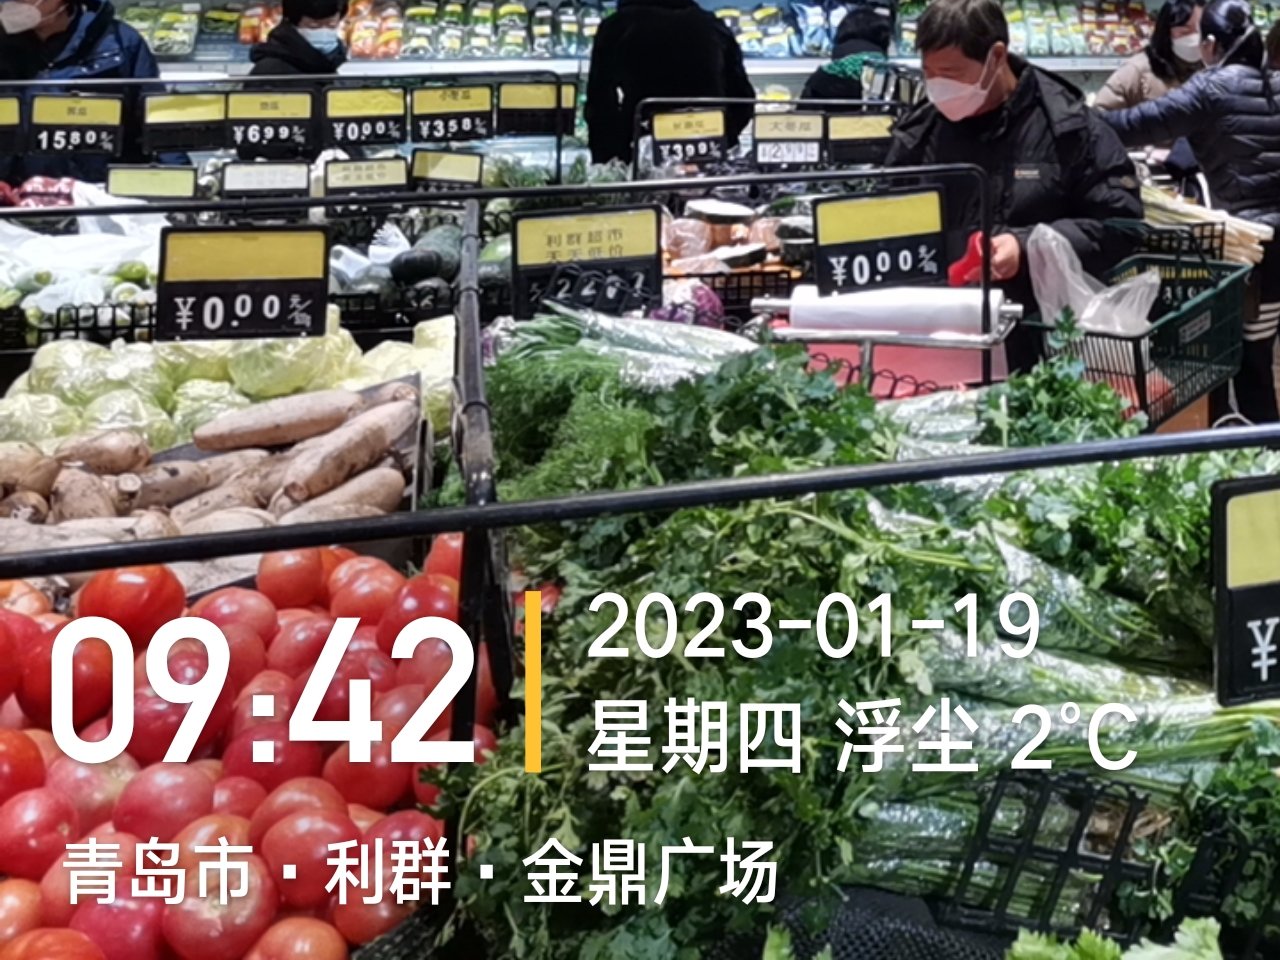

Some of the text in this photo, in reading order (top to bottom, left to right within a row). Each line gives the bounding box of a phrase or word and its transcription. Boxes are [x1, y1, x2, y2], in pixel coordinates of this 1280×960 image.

[546, 228, 623, 248] 利群超市
[829, 249, 913, 287] ¥0.00
[174, 294, 281, 331] ¥0.00
